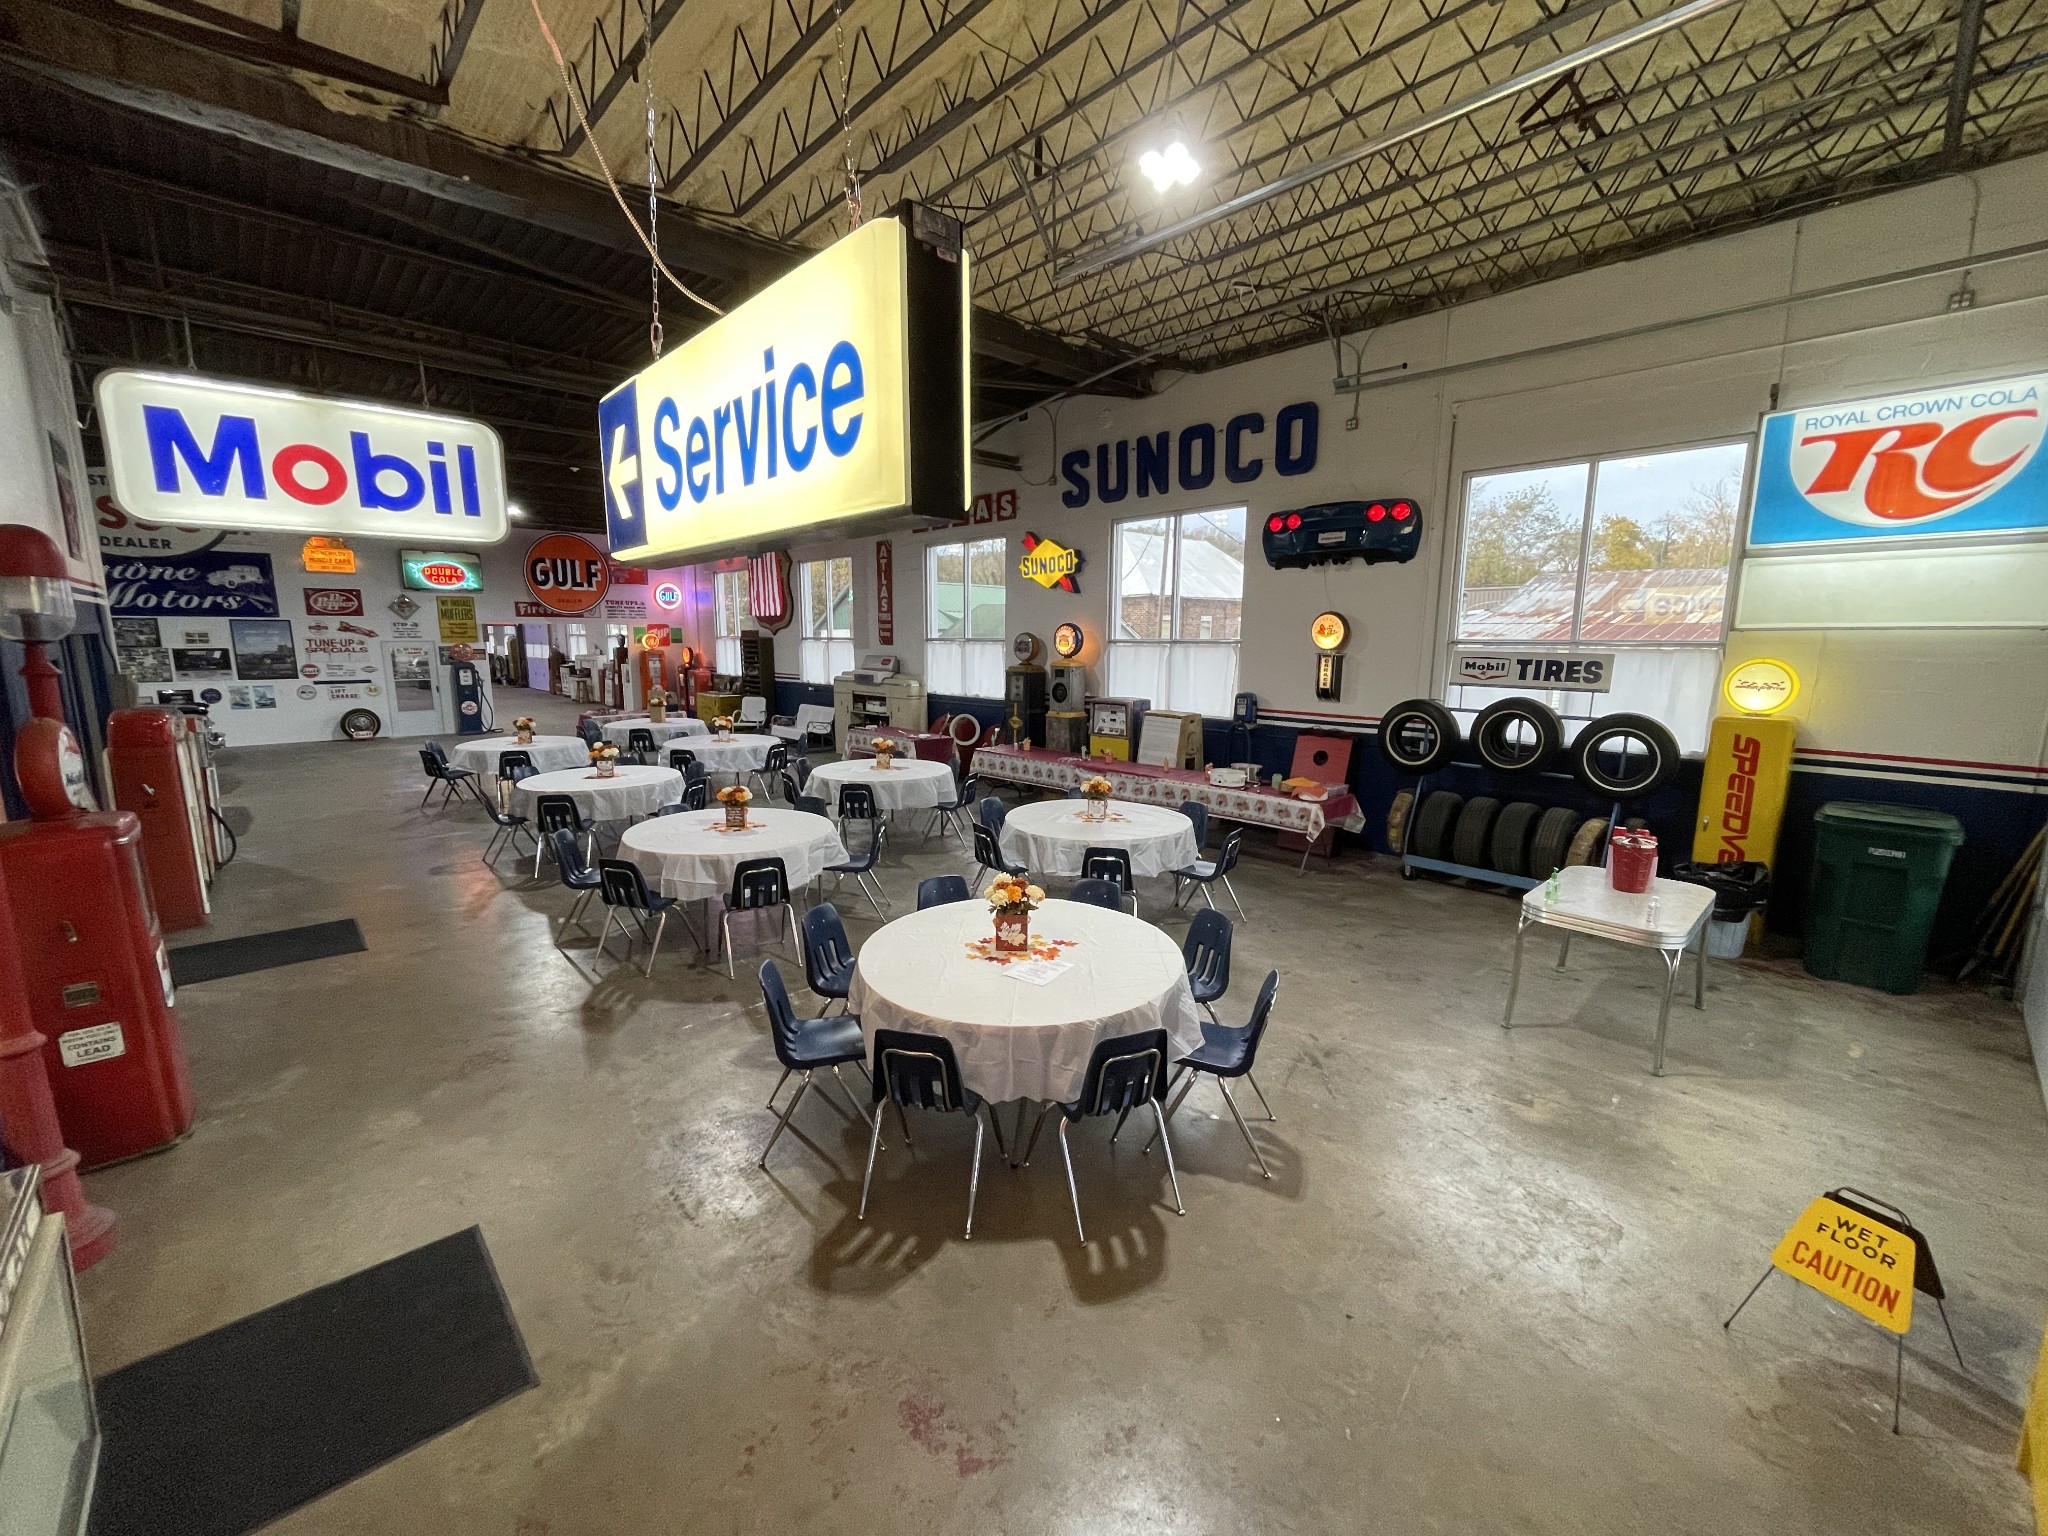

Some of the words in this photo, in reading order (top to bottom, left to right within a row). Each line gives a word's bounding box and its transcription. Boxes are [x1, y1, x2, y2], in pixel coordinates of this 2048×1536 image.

[1805, 410, 1871, 431] ROYAL
[1877, 397, 1962, 422] CROWN
[1970, 386, 2038, 408] COLA
[654, 340, 864, 511] Service
[143, 404, 481, 517] Mobil
[1061, 401, 1318, 508] SUNOCO
[1800, 408, 2038, 520] RC
[100, 536, 172, 550] DEALER
[424, 567, 463, 577] DOUBLE
[531, 557, 601, 591] GULF
[879, 544, 889, 611] ATLAS
[1022, 551, 1075, 576] SUNOCO
[431, 576, 458, 584] COLA
[108, 580, 246, 610] Motors
[316, 597, 355, 611] Pepper
[329, 593, 346, 602] Dr
[659, 590, 678, 601] GULF
[440, 608, 473, 620] MUFFLERS
[305, 638, 355, 648] TUNE-UP
[1322, 658, 1330, 687] GARAGE
[1464, 661, 1506, 673] Mobil
[1516, 658, 1604, 684] TIRES
[1717, 733, 1761, 864] SPEEDVE
[67, 1035, 116, 1051] CONTAINS
[77, 1044, 111, 1058] LEAD
[1816, 1222, 1897, 1270] FLOOR
[1836, 1215, 1888, 1249] WET
[1792, 1240, 1901, 1314] CAUTION
